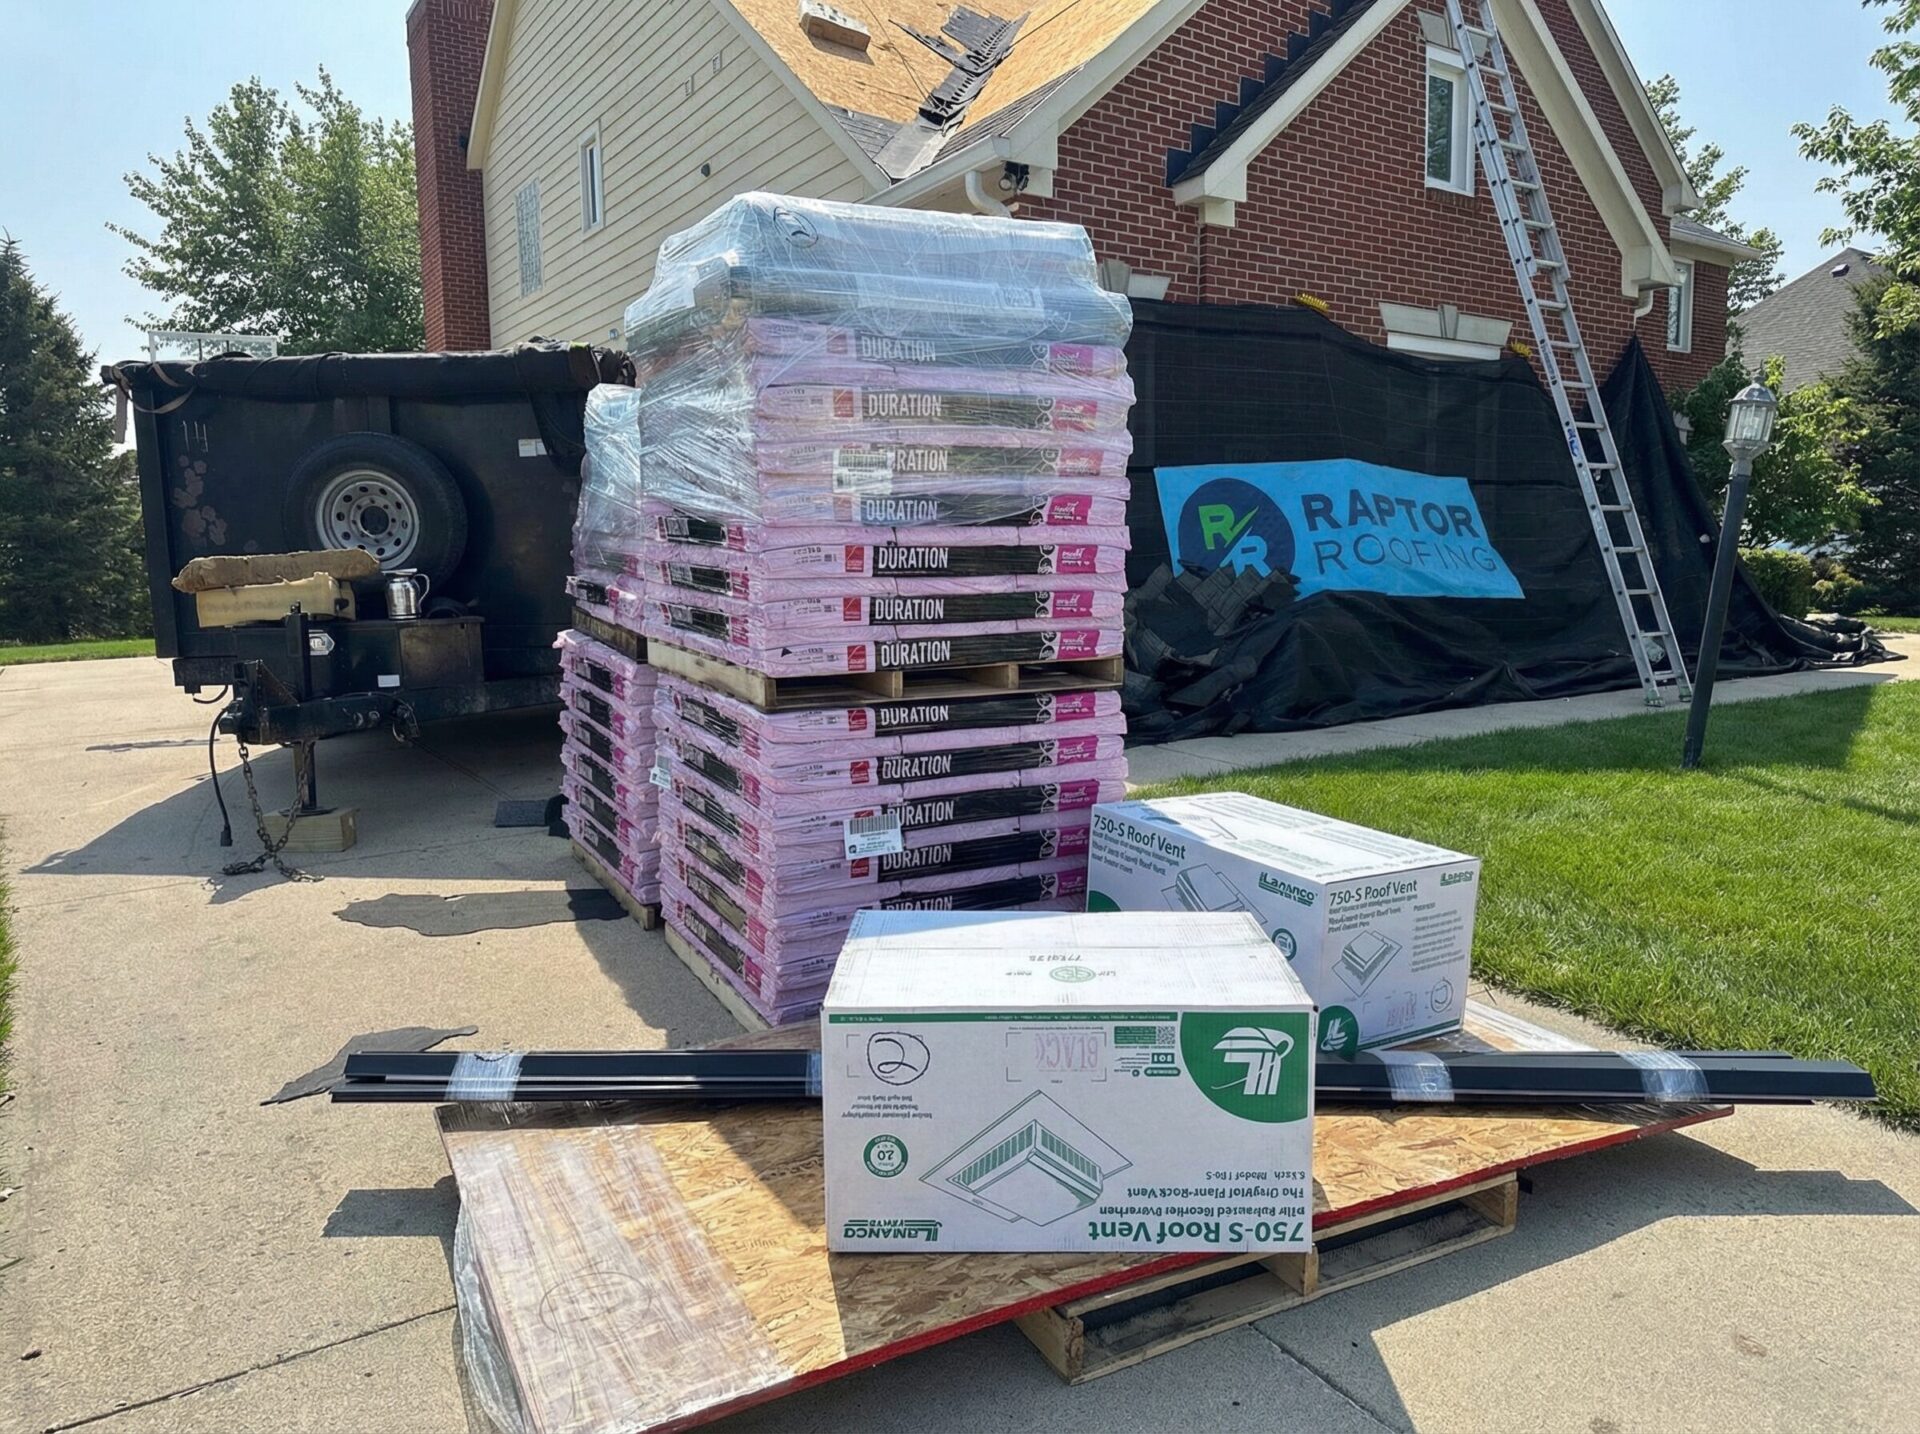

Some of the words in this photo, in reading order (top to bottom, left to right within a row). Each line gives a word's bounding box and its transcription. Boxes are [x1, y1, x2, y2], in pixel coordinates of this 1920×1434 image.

[862, 336, 937, 362] DURATION
[868, 393, 942, 417] DURATION
[893, 449, 949, 472] RATION
[865, 499, 938, 521] DURATION
[1301, 489, 1481, 538] RAPTOR
[877, 547, 949, 570] DURATION
[1313, 532, 1497, 575] ROOFING
[875, 598, 945, 621] DURATION
[880, 640, 951, 668] DURATION
[880, 704, 950, 727] DURATION
[882, 754, 952, 780] DURATION
[1093, 814, 1125, 837] 750-S
[1127, 825, 1156, 848] Roof
[1157, 835, 1186, 860] Vent
[882, 843, 952, 871] DURATION
[1330, 887, 1362, 907] 750-S
[1393, 879, 1418, 895] Vent
[1088, 1221, 1151, 1243] Vent
[1156, 1221, 1220, 1244] Roof
[1228, 1221, 1305, 1244] 750-S
